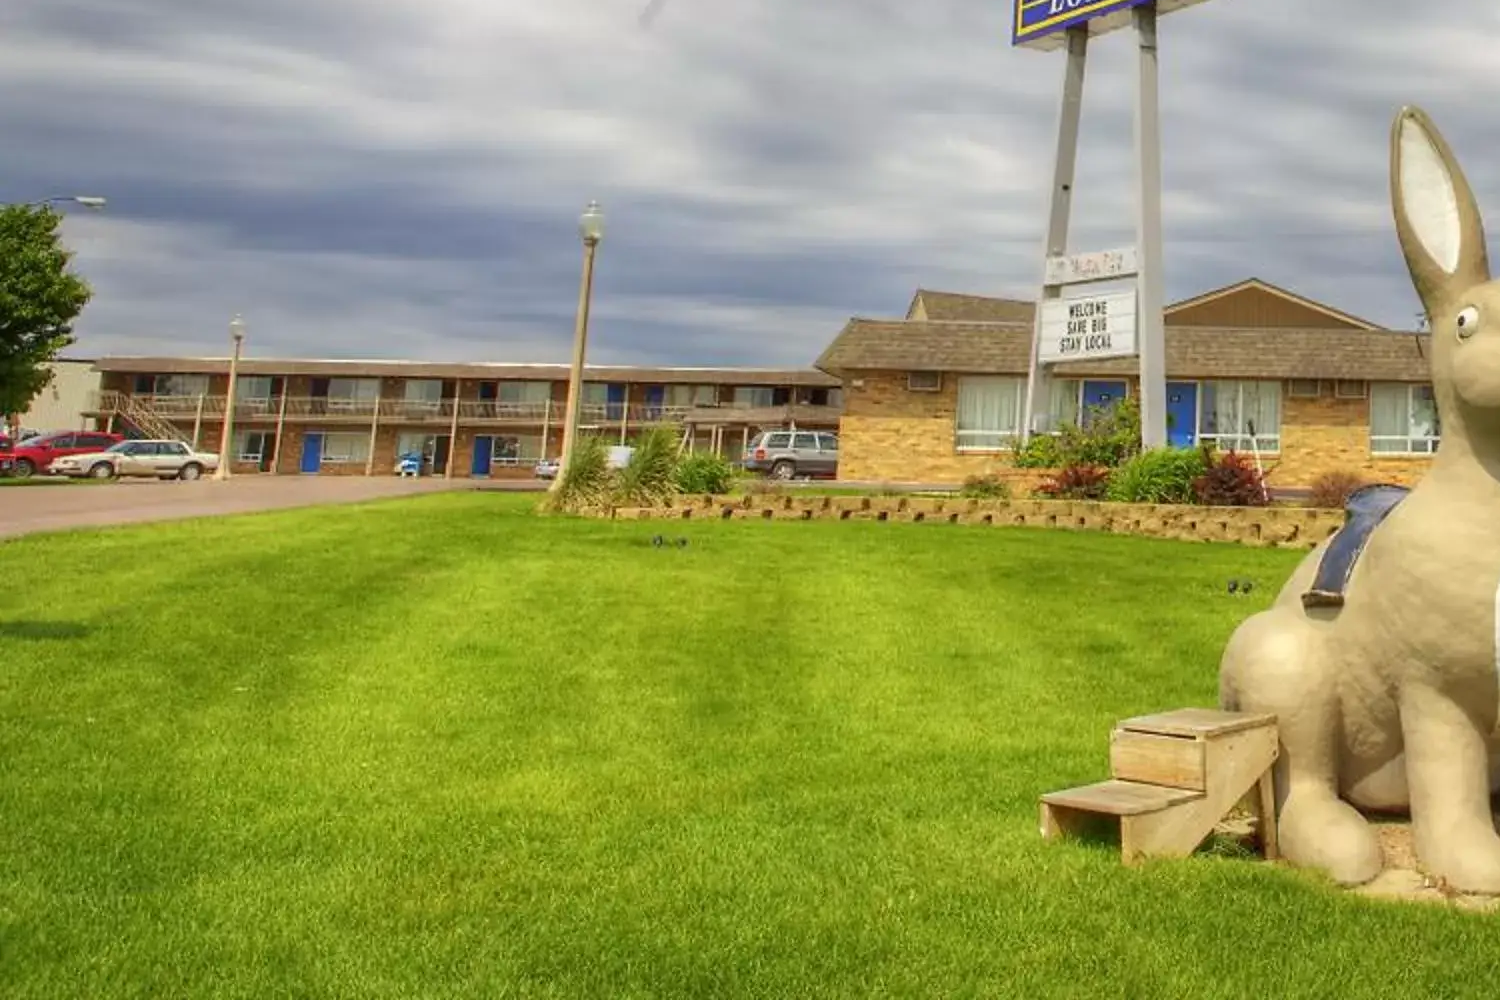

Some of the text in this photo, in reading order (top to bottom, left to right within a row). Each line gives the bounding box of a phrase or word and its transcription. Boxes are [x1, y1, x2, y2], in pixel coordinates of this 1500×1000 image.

[1068, 301, 1107, 318] WELCOME
[1066, 317, 1107, 335] SAVE BIG
[1060, 334, 1112, 353] STAY LOCAL
